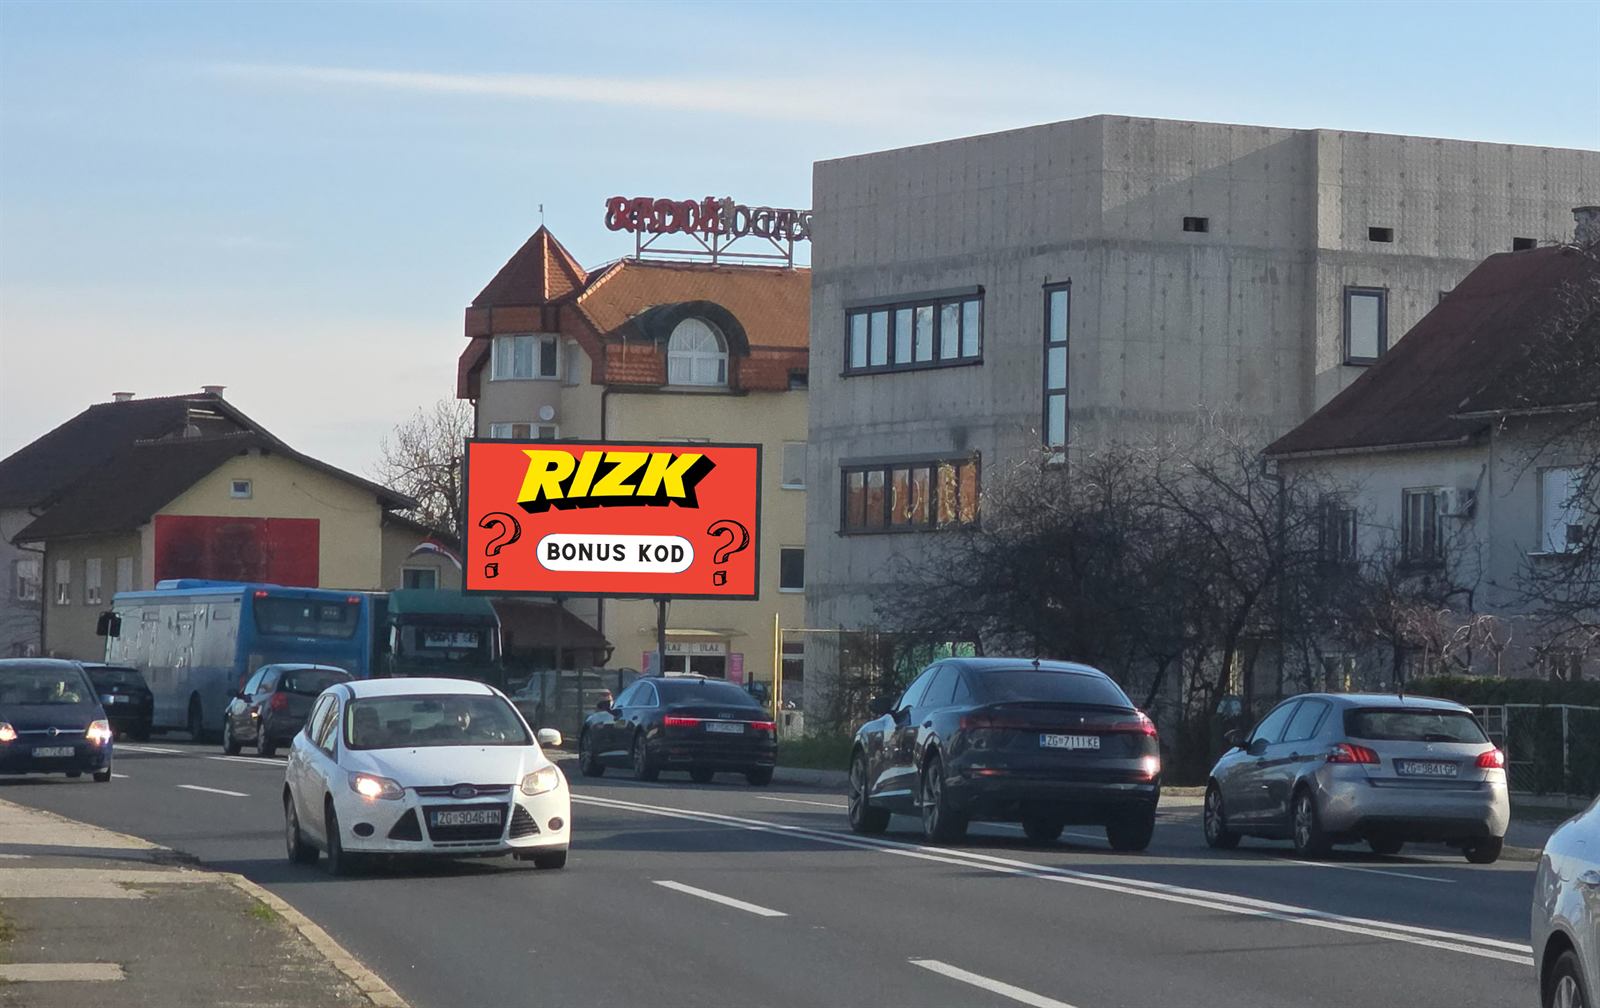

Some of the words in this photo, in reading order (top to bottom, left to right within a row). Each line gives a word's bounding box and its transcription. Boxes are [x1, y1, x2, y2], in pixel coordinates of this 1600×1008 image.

[516, 450, 716, 514] RIZK
[547, 542, 626, 562] BONUS
[638, 544, 684, 563] KOD
